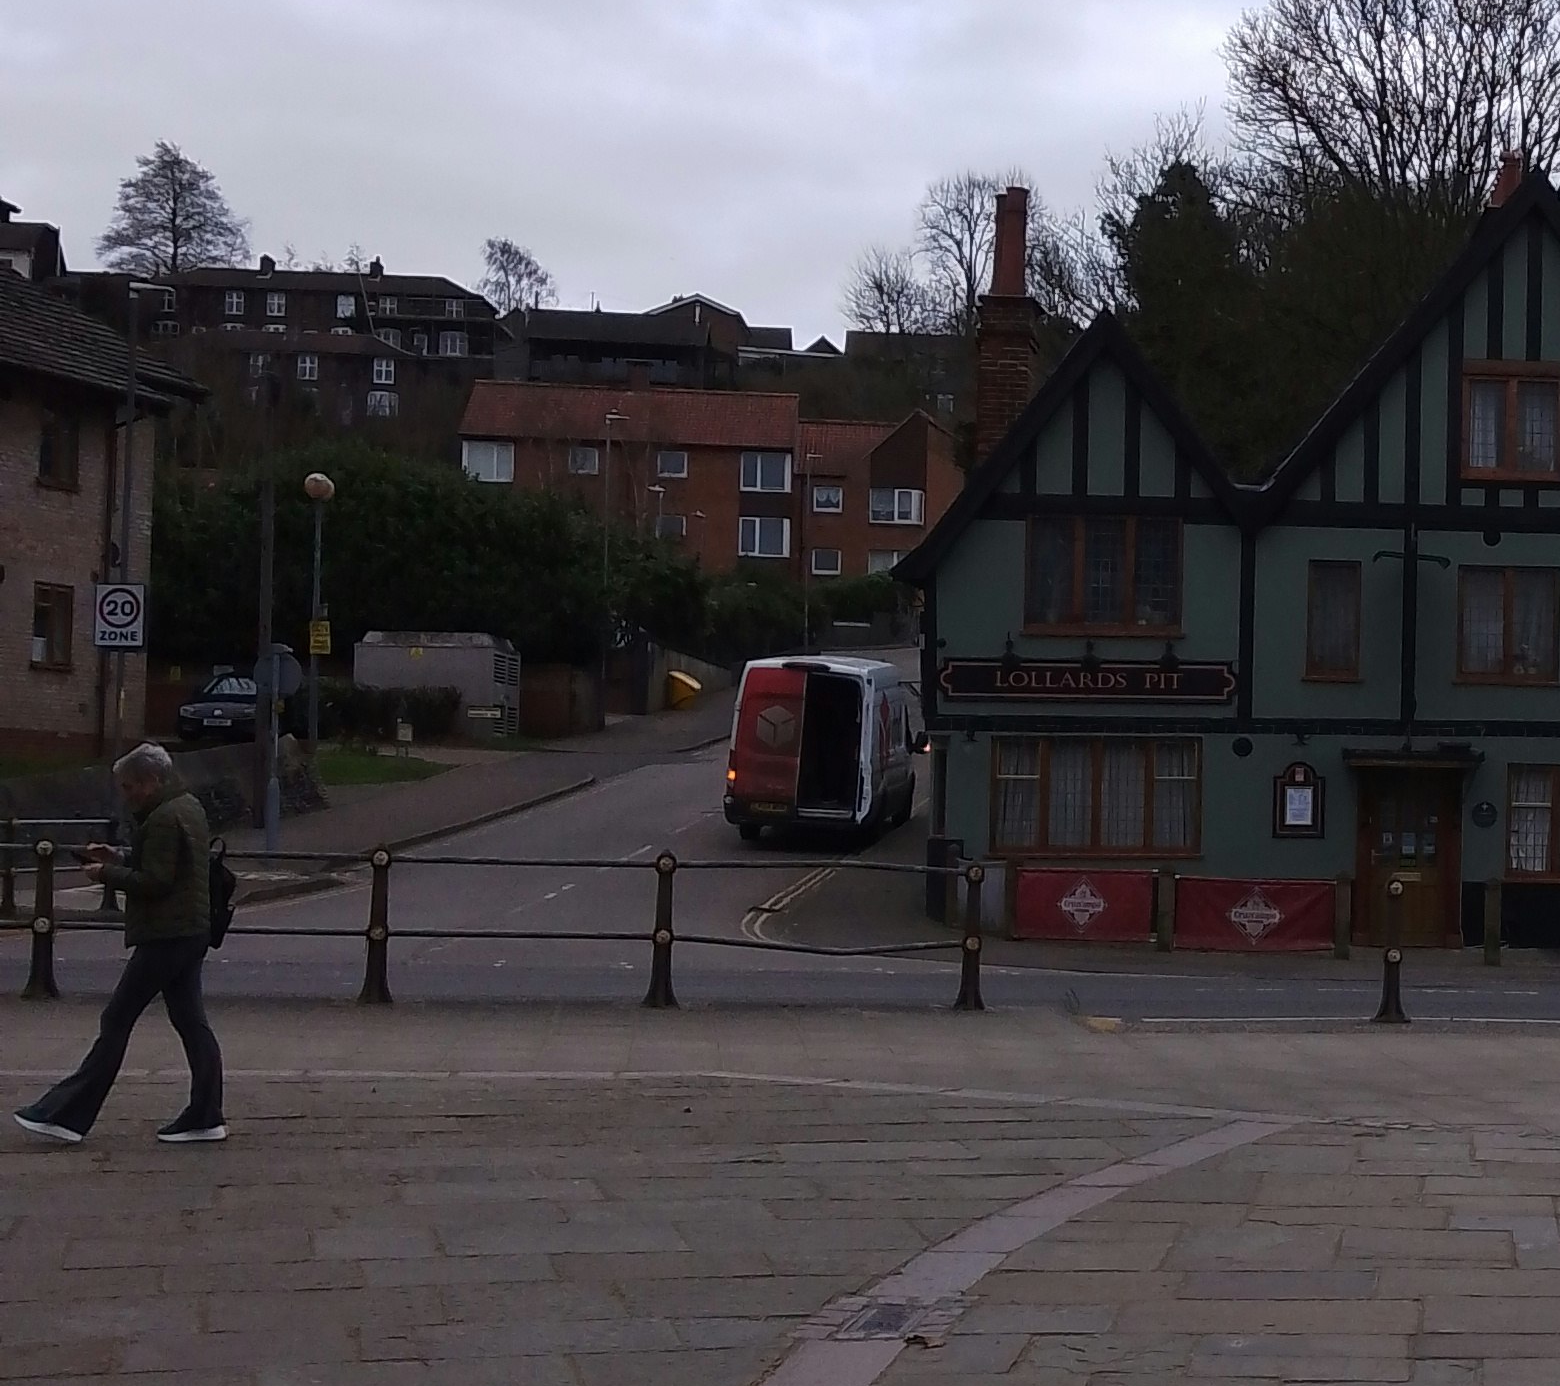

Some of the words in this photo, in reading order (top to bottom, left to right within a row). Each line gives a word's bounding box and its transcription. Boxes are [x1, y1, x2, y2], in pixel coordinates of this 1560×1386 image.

[105, 600, 134, 616] 20
[99, 630, 138, 641] ZONE
[995, 670, 1127, 689] LOLLARDS
[1144, 673, 1184, 690] PIT
